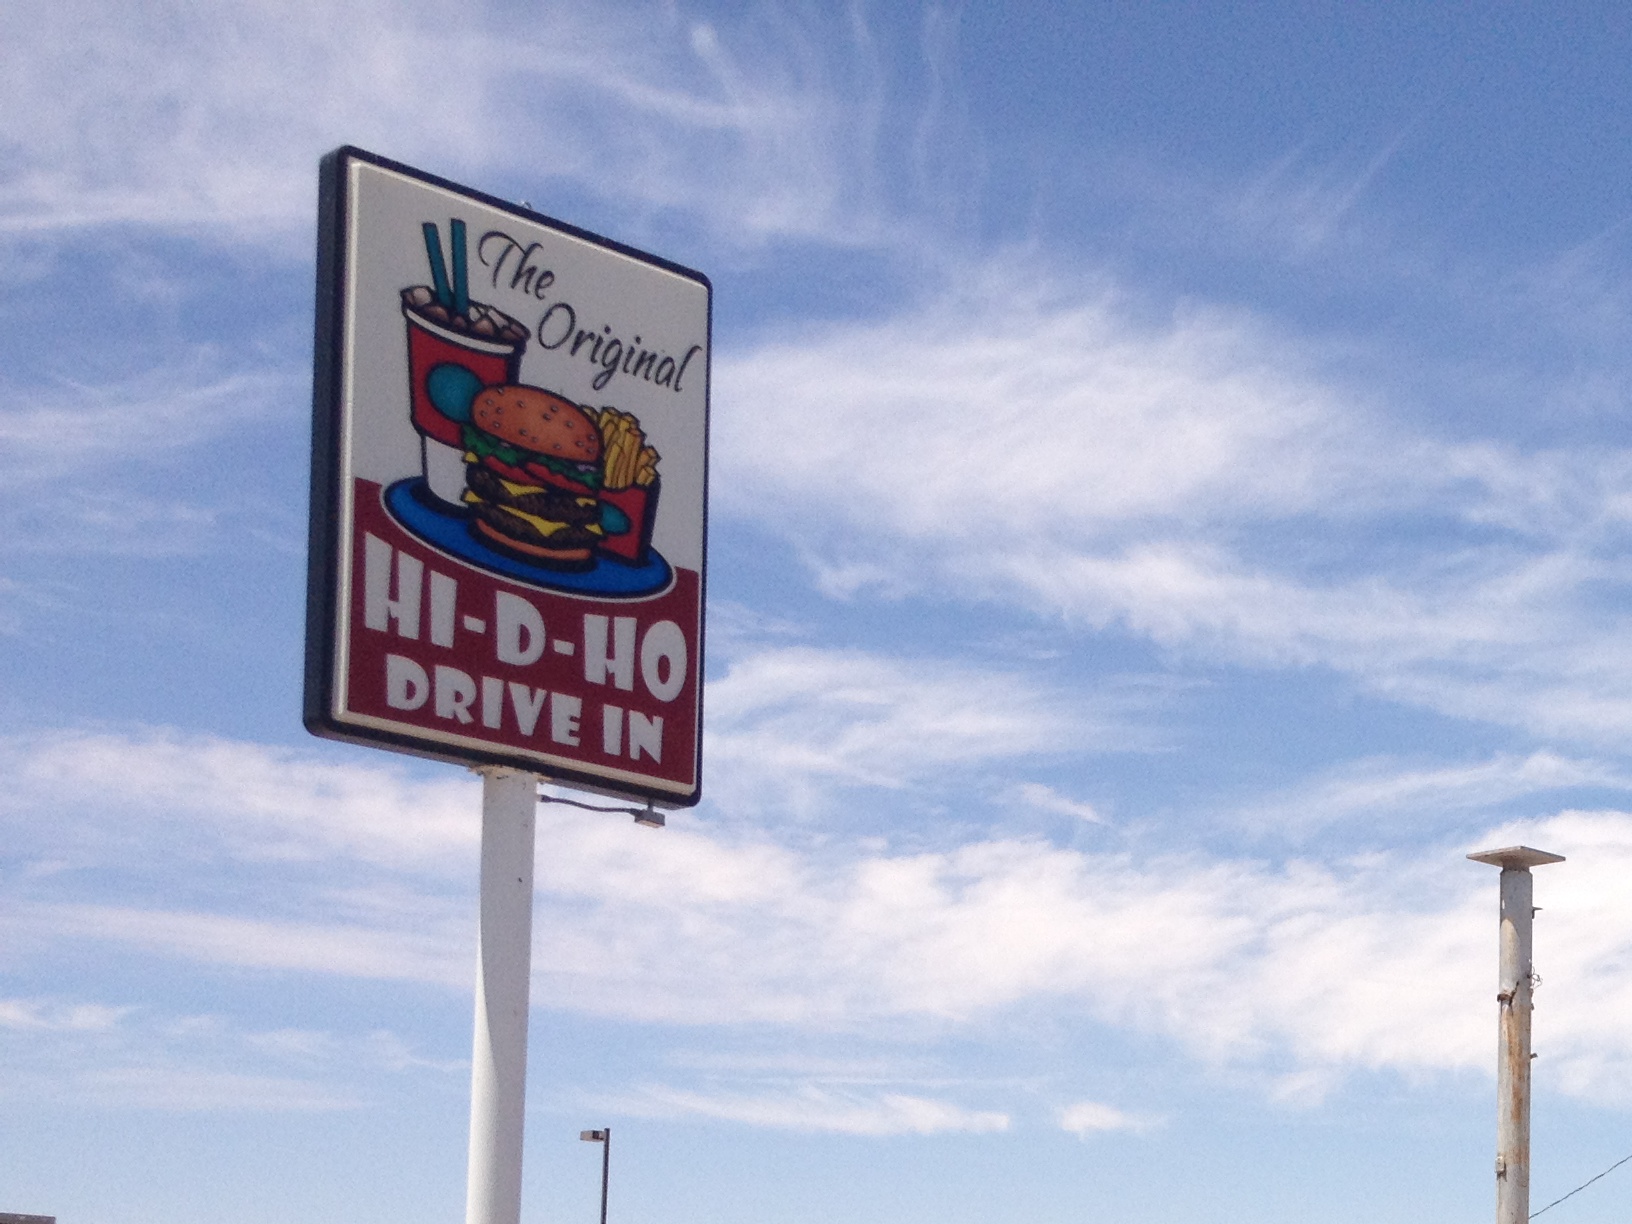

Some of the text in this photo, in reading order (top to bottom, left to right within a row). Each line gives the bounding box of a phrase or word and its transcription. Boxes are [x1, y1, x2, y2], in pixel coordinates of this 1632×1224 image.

[477, 230, 556, 300] The
[536, 301, 704, 393] Original
[363, 531, 688, 702] HI-D-HO
[385, 653, 665, 765] DRIVE IN
